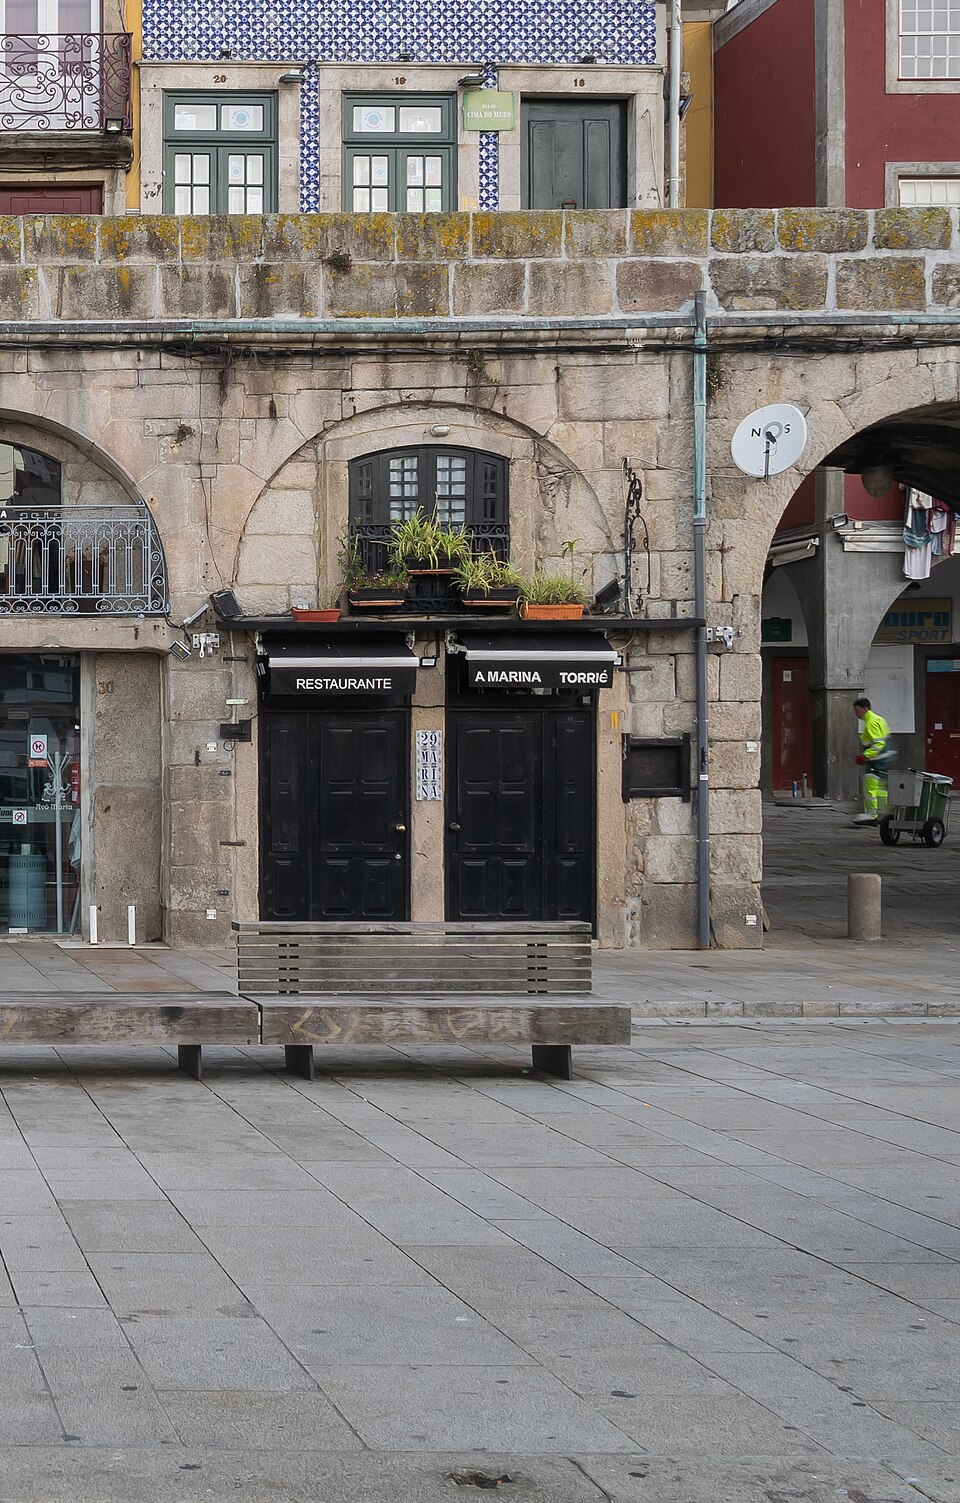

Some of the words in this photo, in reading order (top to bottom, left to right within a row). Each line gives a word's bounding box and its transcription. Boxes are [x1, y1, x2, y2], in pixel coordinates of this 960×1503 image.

[213, 75, 227, 84] 20
[394, 77, 407, 86] 19
[751, 422, 791, 438] NOS
[897, 629, 950, 642] SPORT
[475, 671, 485, 683] A
[487, 671, 542, 683] MARINA
[296, 678, 392, 690] RESTAURANTE
[420, 733, 437, 746] 29
